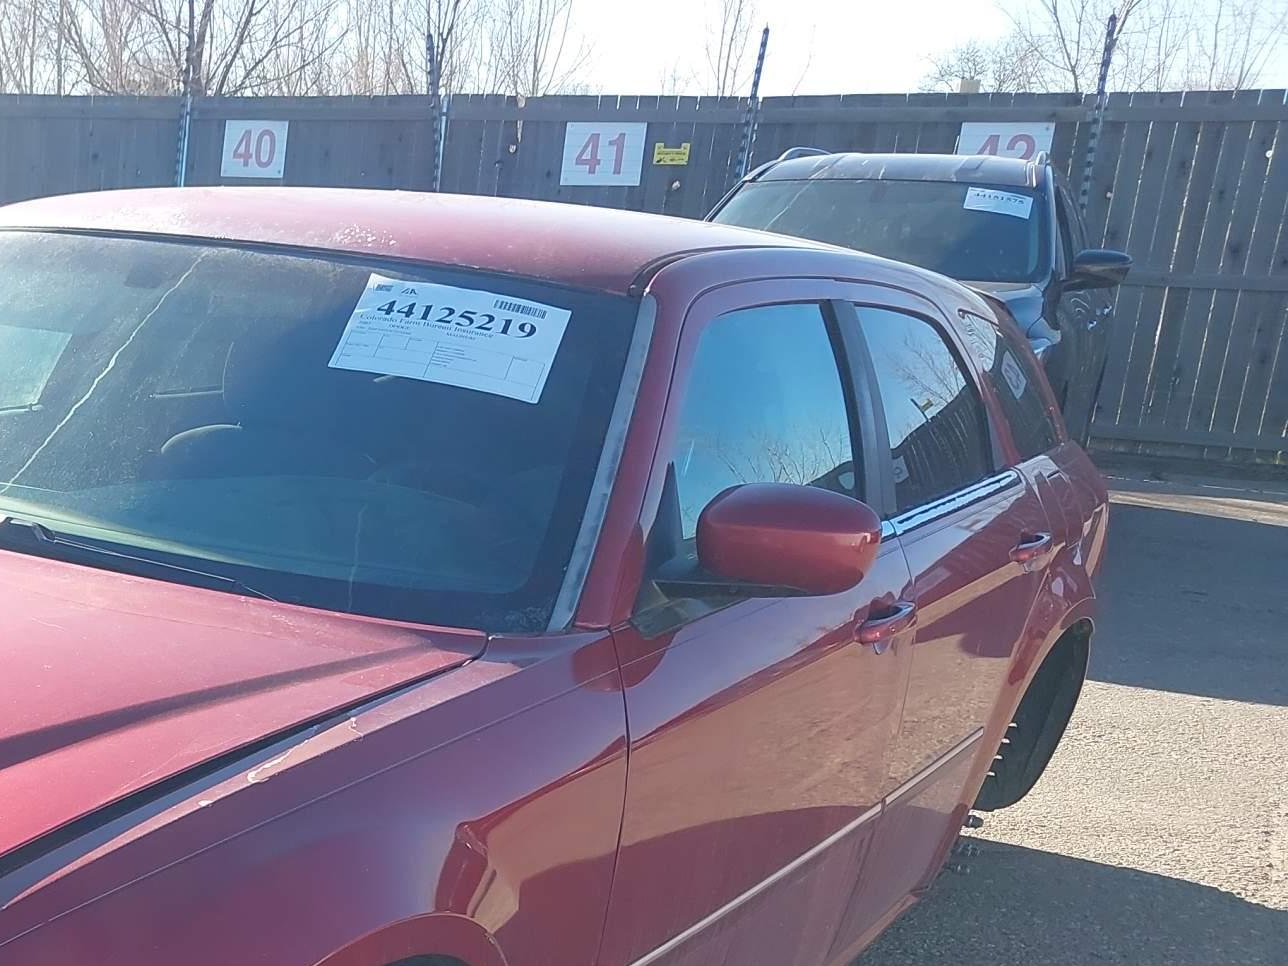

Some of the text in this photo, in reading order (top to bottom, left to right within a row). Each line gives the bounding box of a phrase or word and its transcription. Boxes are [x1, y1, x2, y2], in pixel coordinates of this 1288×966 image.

[232, 128, 276, 168] 40
[575, 132, 627, 175] 41
[377, 299, 537, 338] 44125219
